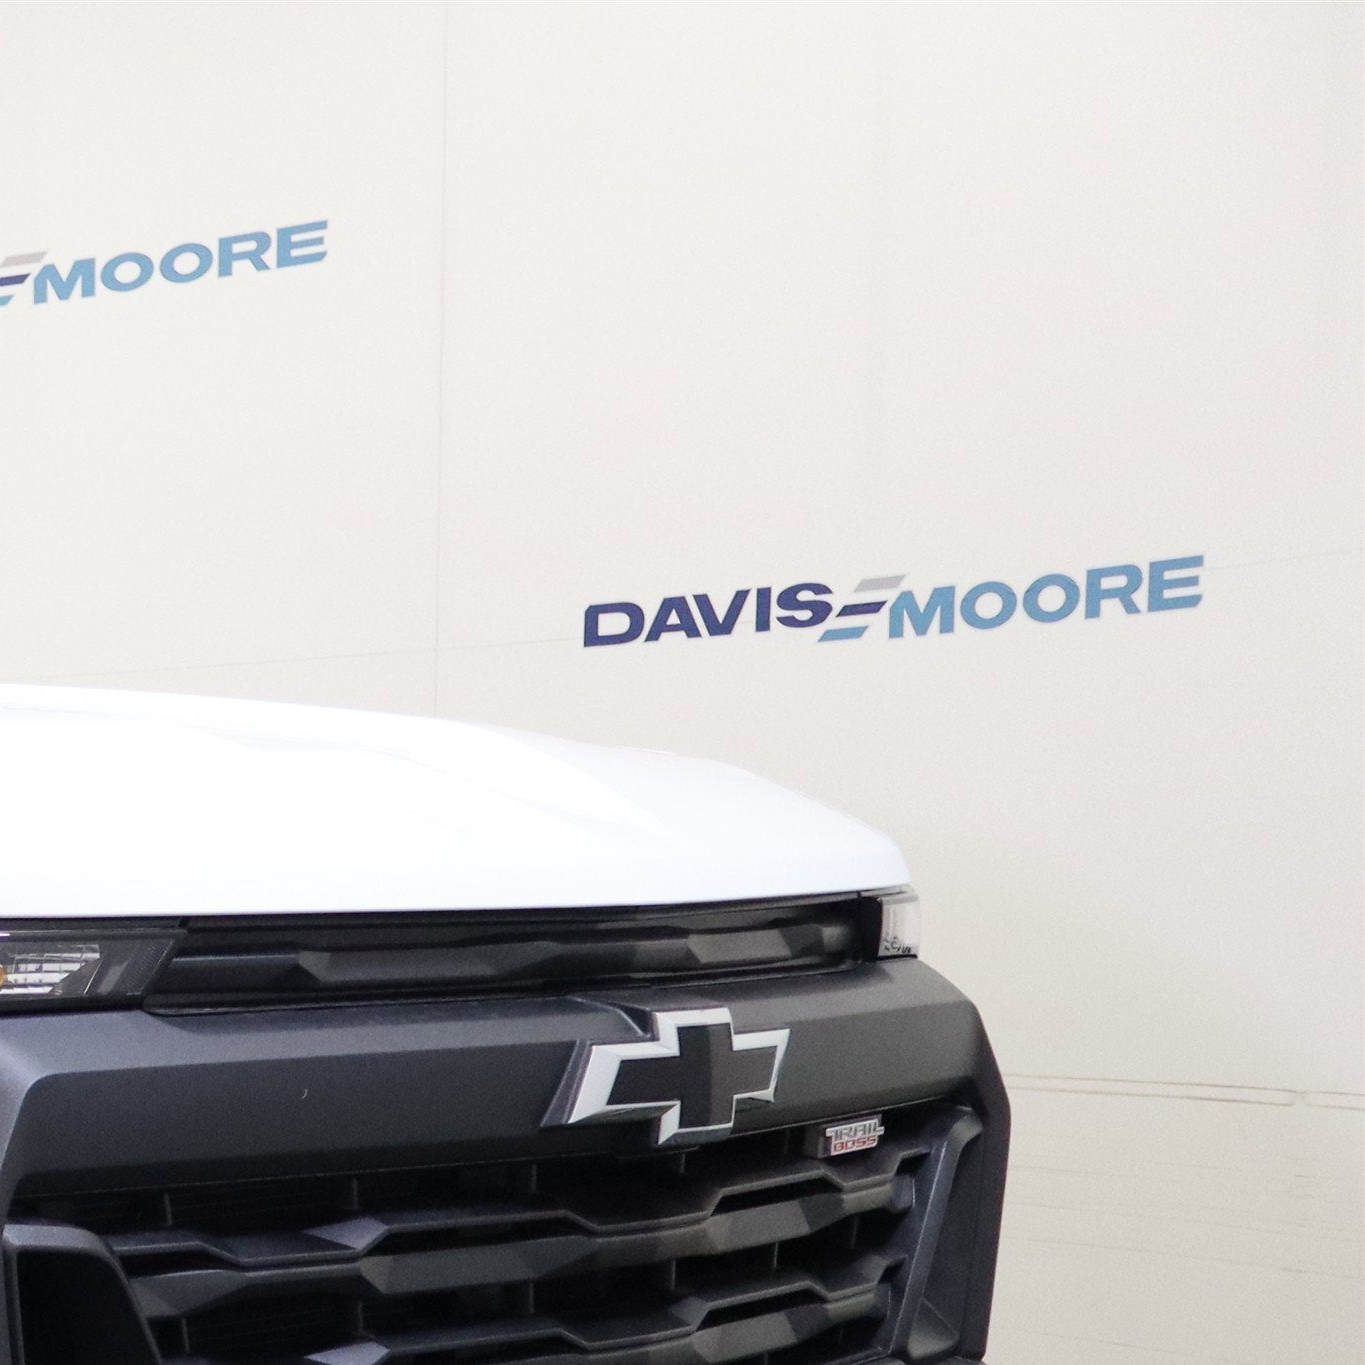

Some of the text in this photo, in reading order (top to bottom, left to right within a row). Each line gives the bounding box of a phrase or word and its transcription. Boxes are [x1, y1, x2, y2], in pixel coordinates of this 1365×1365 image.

[32, 220, 329, 305] MOORE
[582, 554, 1205, 648] DAVIS MOORE
[826, 1120, 885, 1141] TRAIL
[832, 1136, 877, 1153] BOSS
